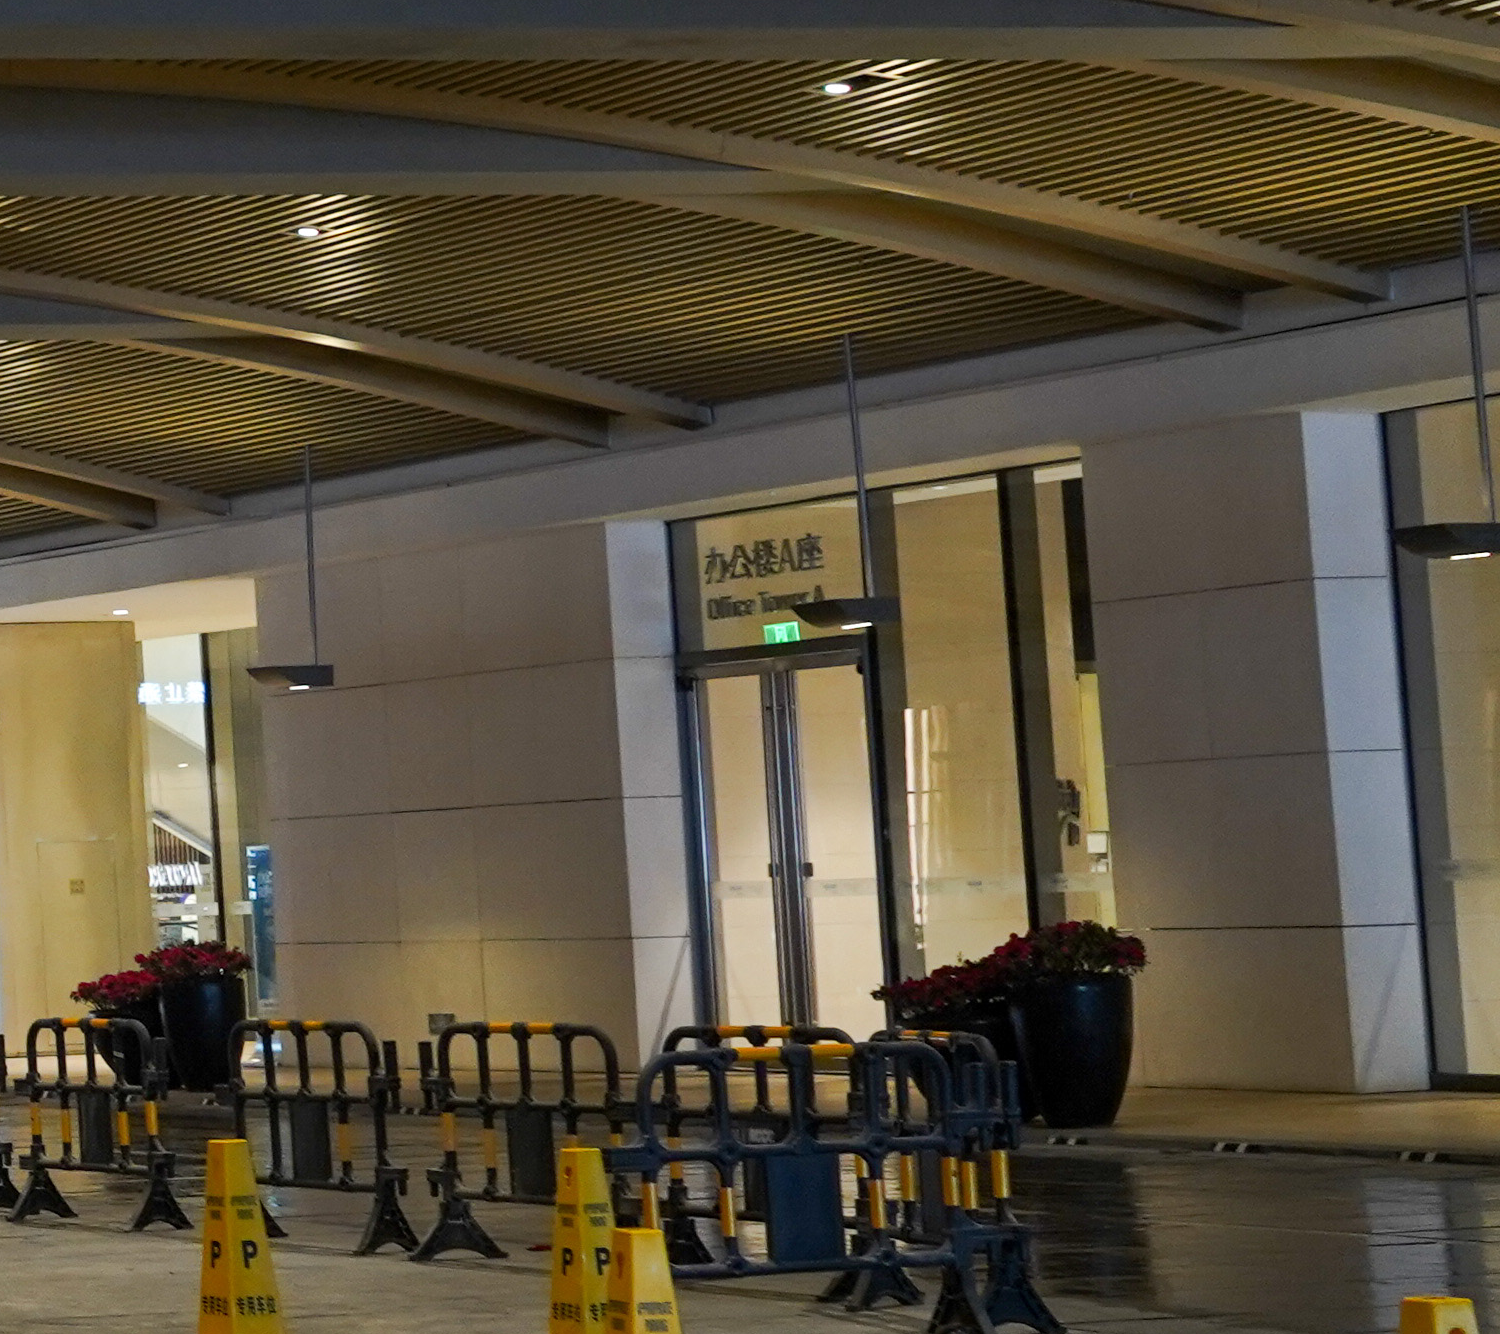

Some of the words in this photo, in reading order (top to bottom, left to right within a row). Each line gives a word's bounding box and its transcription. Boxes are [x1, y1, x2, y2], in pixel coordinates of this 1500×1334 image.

[704, 533, 824, 584] 办公楼A座
[707, 595, 755, 620] Office
[210, 1240, 222, 1269] P
[241, 1240, 258, 1269] P
[562, 1247, 574, 1276] P
[595, 1247, 610, 1276] P
[236, 1295, 277, 1316] 专用车位
